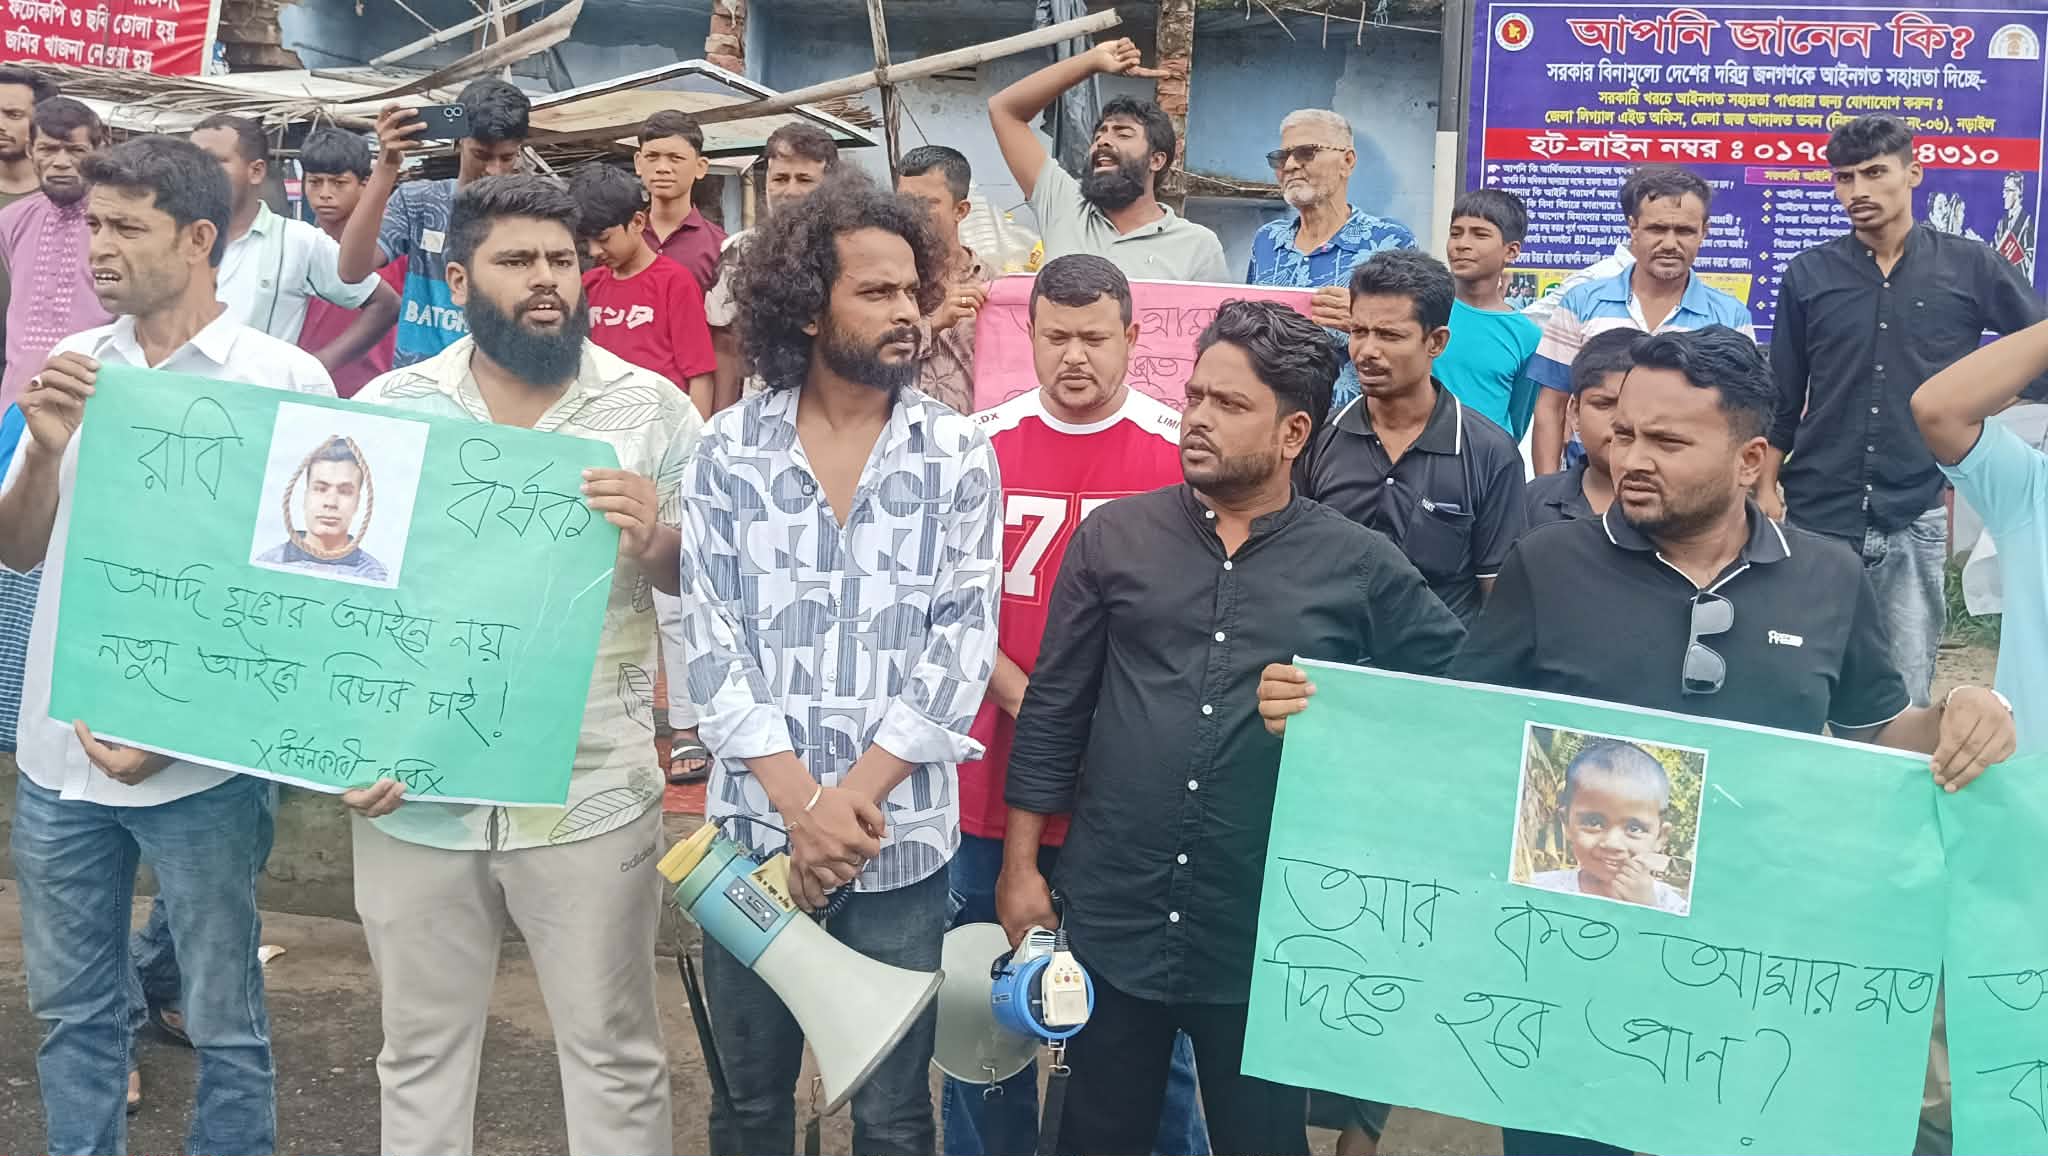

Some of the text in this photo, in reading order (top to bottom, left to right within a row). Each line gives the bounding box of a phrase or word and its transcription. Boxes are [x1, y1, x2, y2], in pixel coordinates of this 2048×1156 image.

[5, 25, 41, 56] জমির
[44, 34, 84, 63] খাজনা
[70, 8, 83, 27] ও
[86, 5, 109, 33] ছবি
[114, 13, 152, 39] তোলা
[156, 19, 178, 45] হয়
[1566, 7, 1720, 56] আপনি
[1725, 14, 1879, 58] জানেন
[1886, 11, 1975, 60] কি?
[1546, 58, 1987, 91] সরকার বিনামূল্যে দেশের দরিদ্র জনগণকে আইনগত সহায়তা দিচ্ছে-
[1545, 109, 1573, 124] জেলা
[1618, 108, 1646, 124] এইড
[1691, 112, 1720, 126] জেলা
[1598, 88, 1640, 106] সরকারি
[1675, 89, 1725, 107] আইনগত
[1728, 92, 1769, 108] সহায়তা
[1846, 94, 1900, 110] যোগাযোগ
[1527, 130, 1652, 161] হট-লাইন
[1658, 137, 1721, 160] নম্বর
[1157, 415, 1181, 430] LIMI
[130, 396, 245, 501] রবি
[83, 556, 214, 620] আদি
[450, 616, 520, 662] নয়
[98, 632, 191, 703] নতুন
[322, 651, 415, 715] বিচার
[1278, 856, 1460, 948] আর
[1494, 900, 1620, 983] কত
[1638, 932, 1857, 1016] আমার
[1855, 966, 1935, 1024] মত
[1262, 934, 1424, 1036] দিতে
[1434, 992, 1562, 1104] হবে
